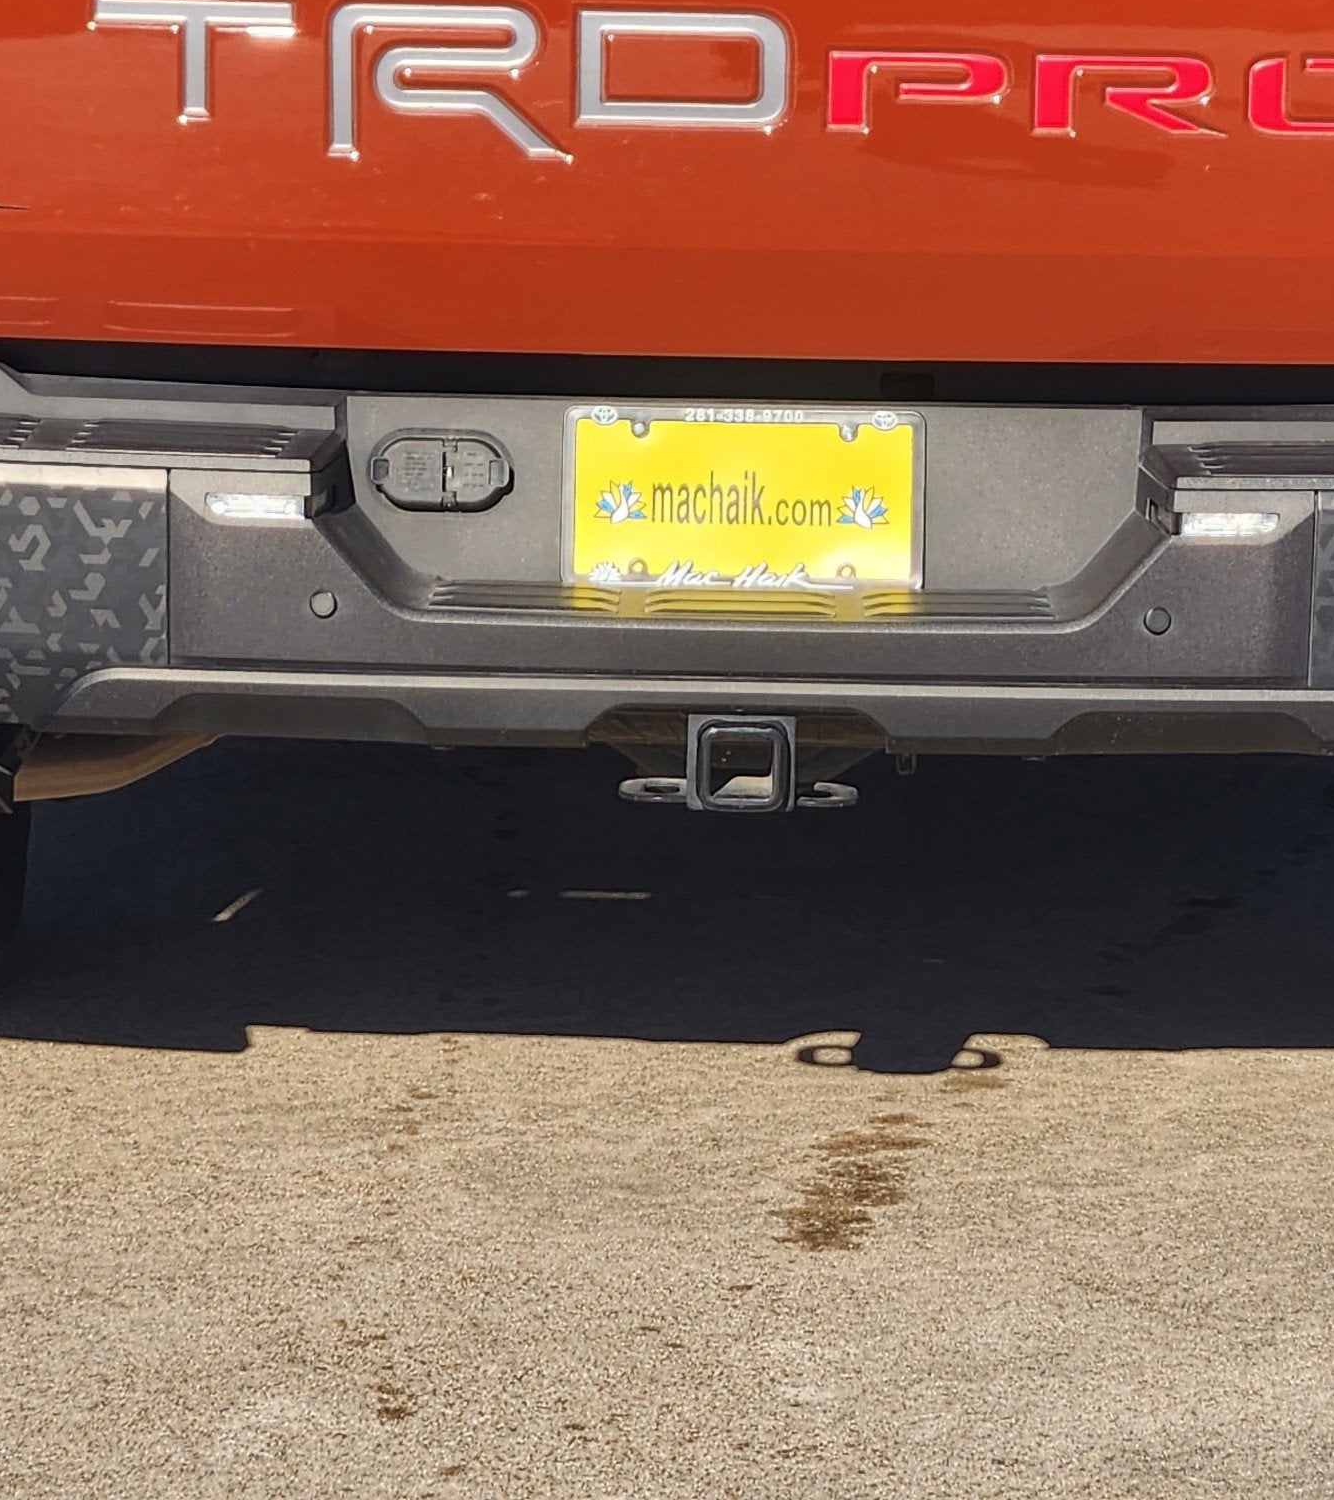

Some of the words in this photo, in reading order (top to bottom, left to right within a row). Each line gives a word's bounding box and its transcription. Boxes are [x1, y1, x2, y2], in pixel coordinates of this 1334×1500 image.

[650, 470, 833, 527] machaik.com
[655, 560, 729, 588] Mac
[730, 560, 825, 589] Haik
